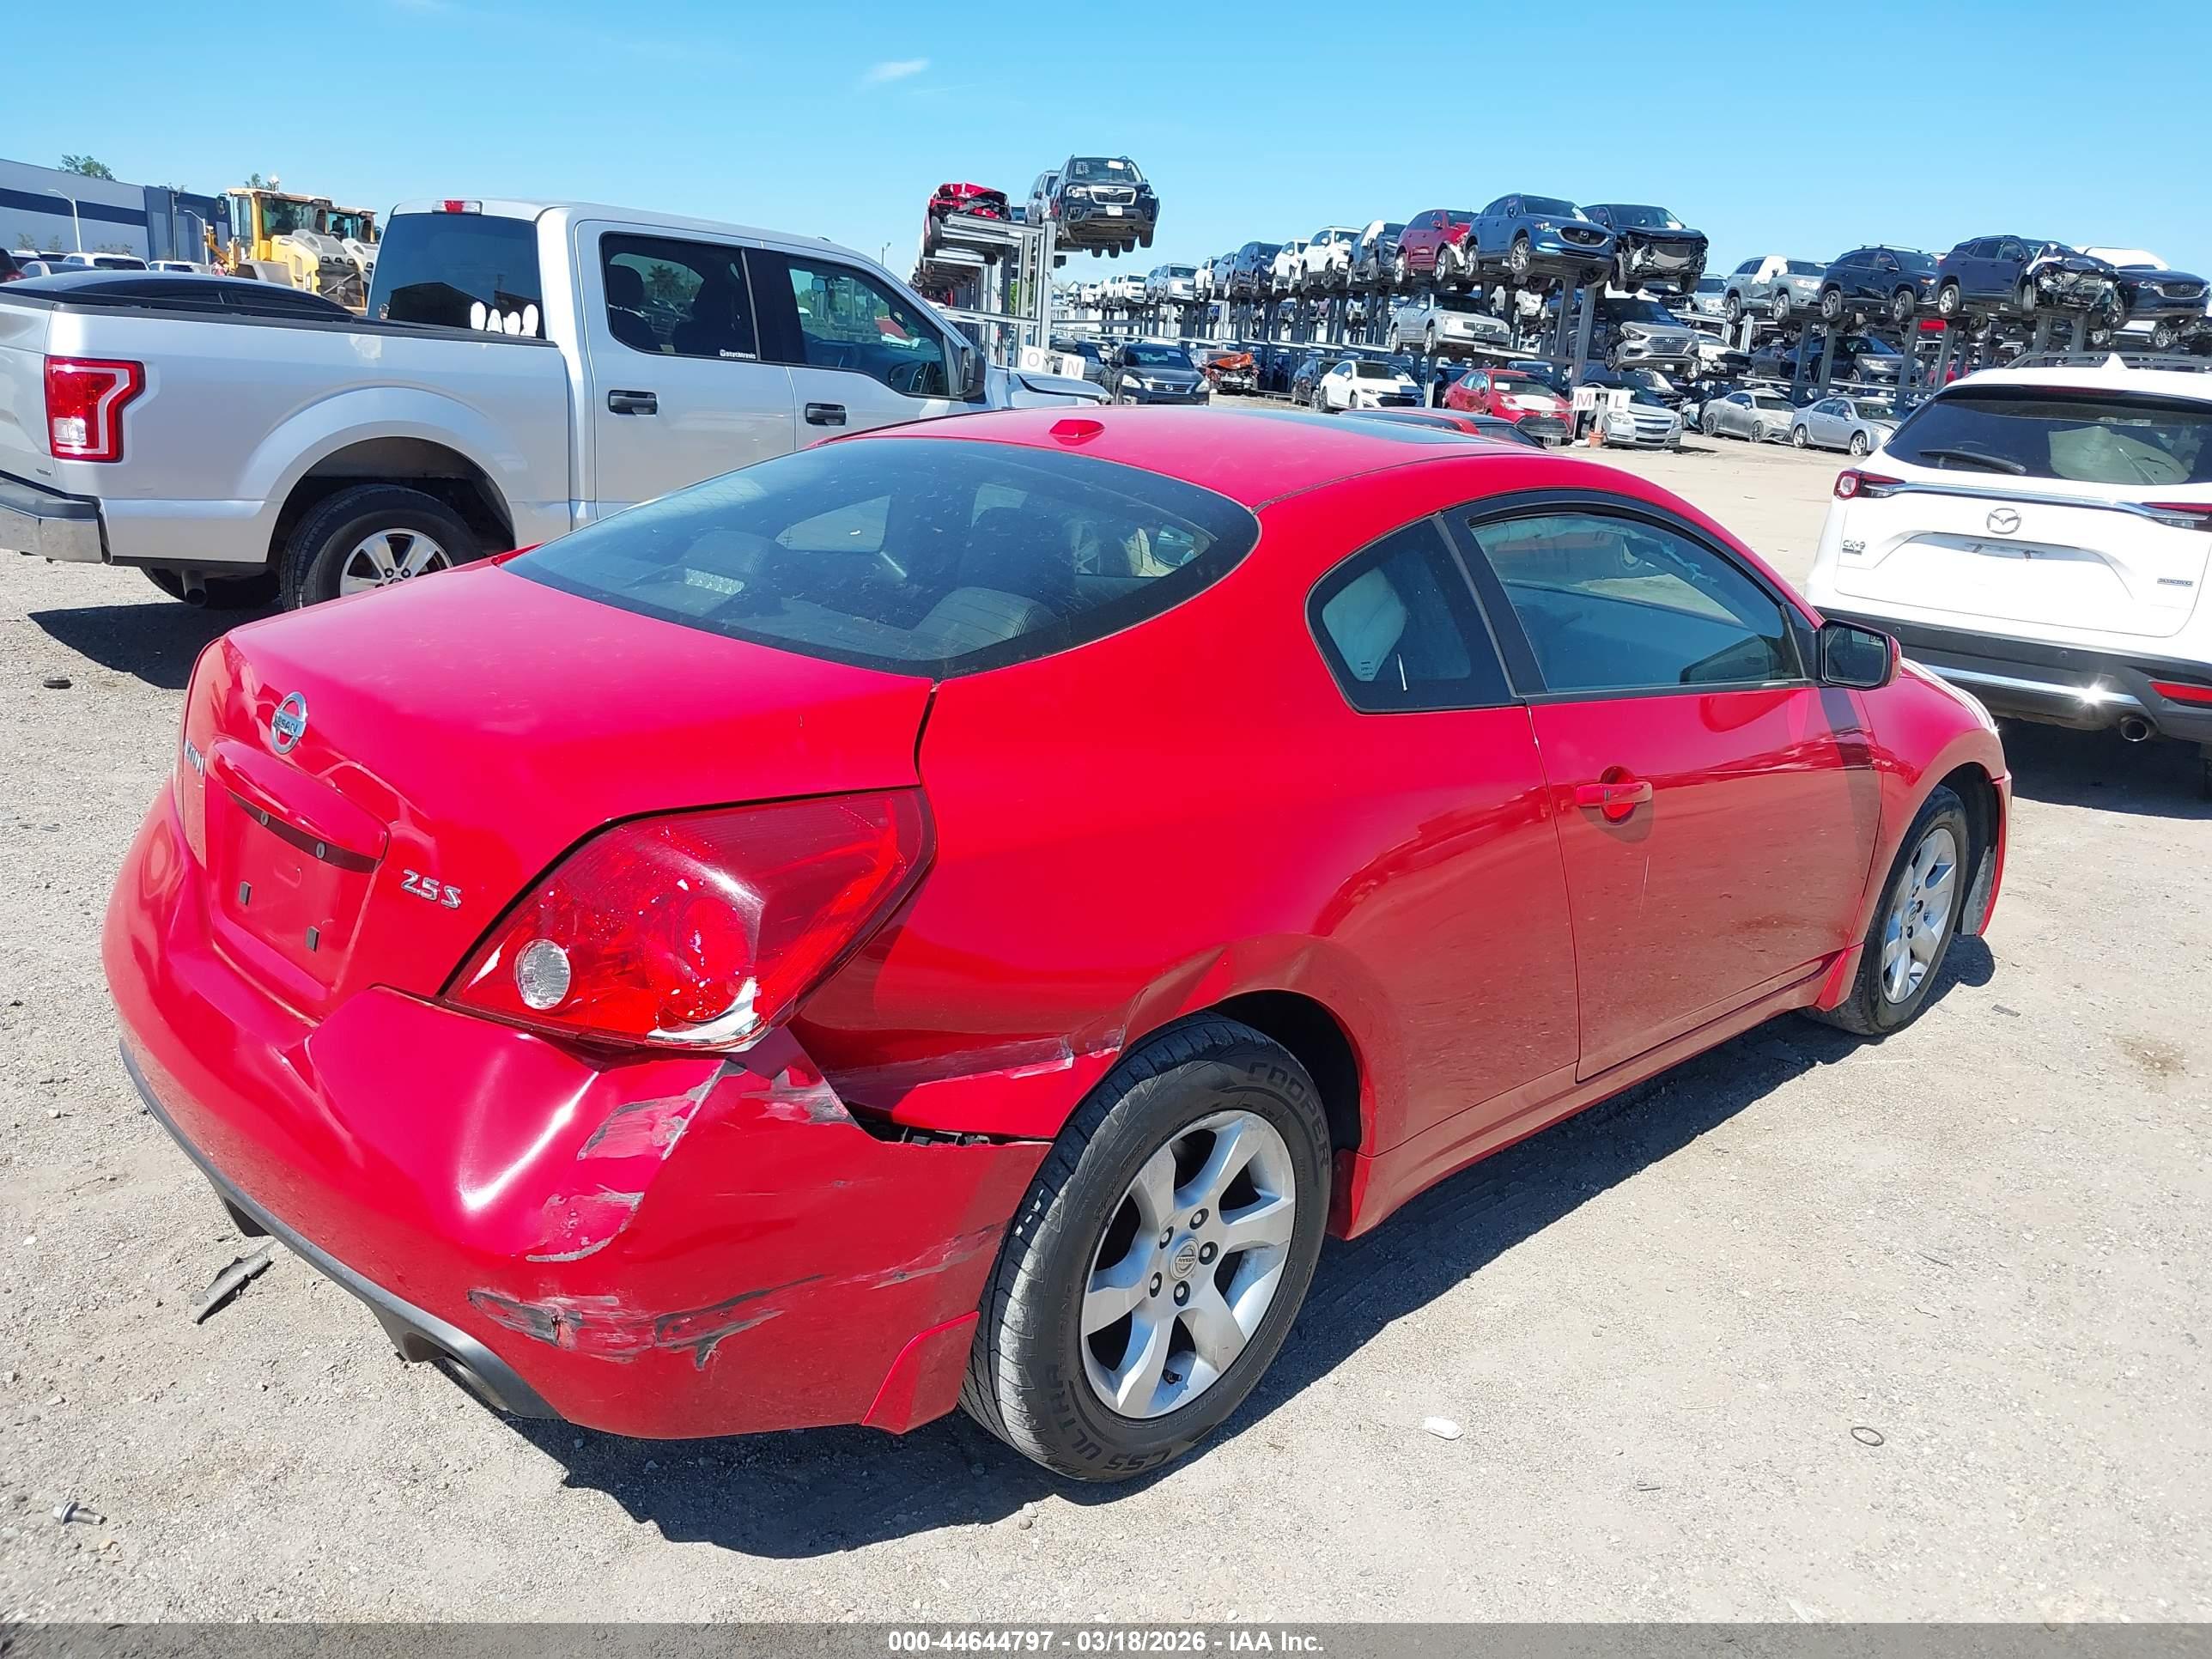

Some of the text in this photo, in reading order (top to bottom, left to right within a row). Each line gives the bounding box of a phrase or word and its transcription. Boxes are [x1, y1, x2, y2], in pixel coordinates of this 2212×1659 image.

[1066, 360, 1080, 376] N
[1576, 392, 1593, 407] M
[1613, 395, 1623, 409] L
[1248, 1061, 1329, 1169] COOPER
